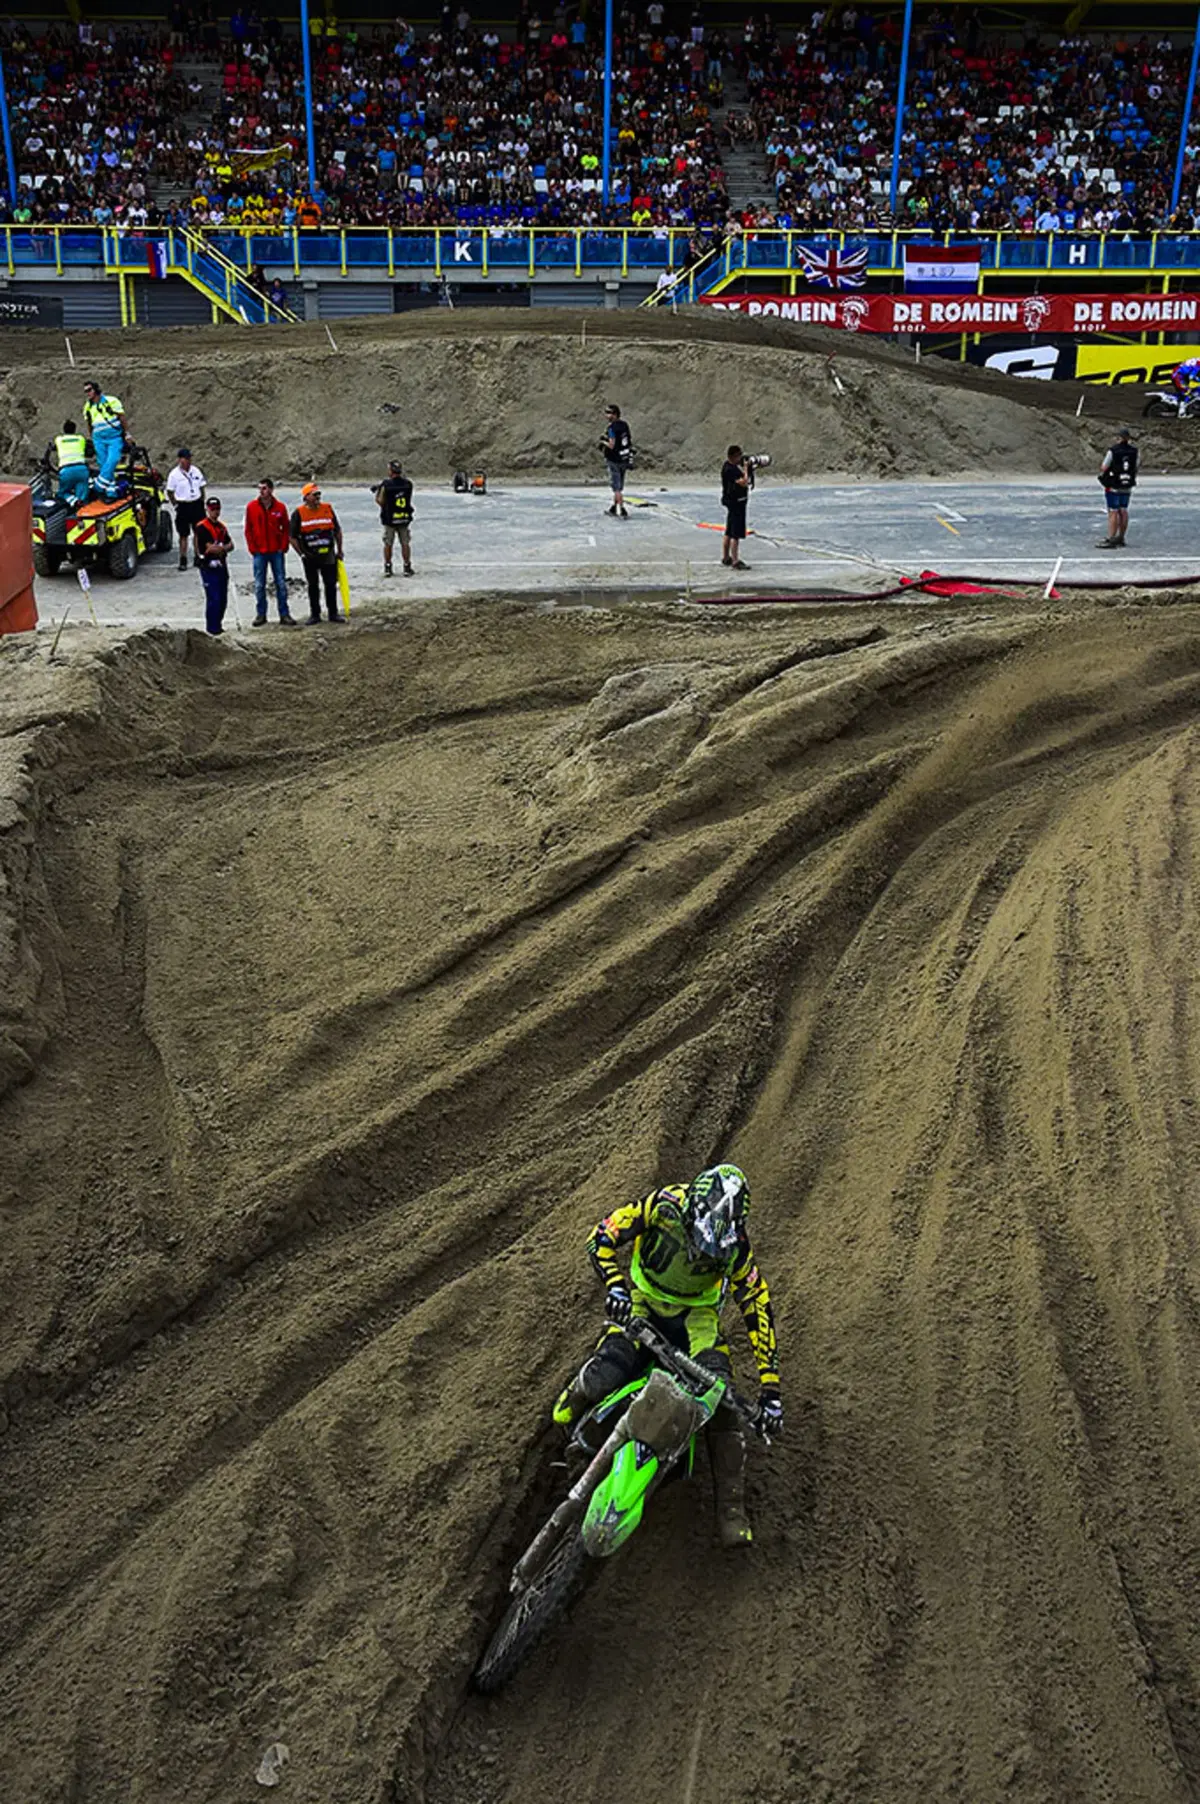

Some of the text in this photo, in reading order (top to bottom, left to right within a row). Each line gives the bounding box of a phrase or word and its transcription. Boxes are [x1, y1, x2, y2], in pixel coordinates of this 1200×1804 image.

[455, 241, 473, 261] K
[1068, 244, 1087, 264] H
[893, 302, 1018, 322] DE ROMEIN
[1074, 300, 1197, 322] DE ROMEIN
